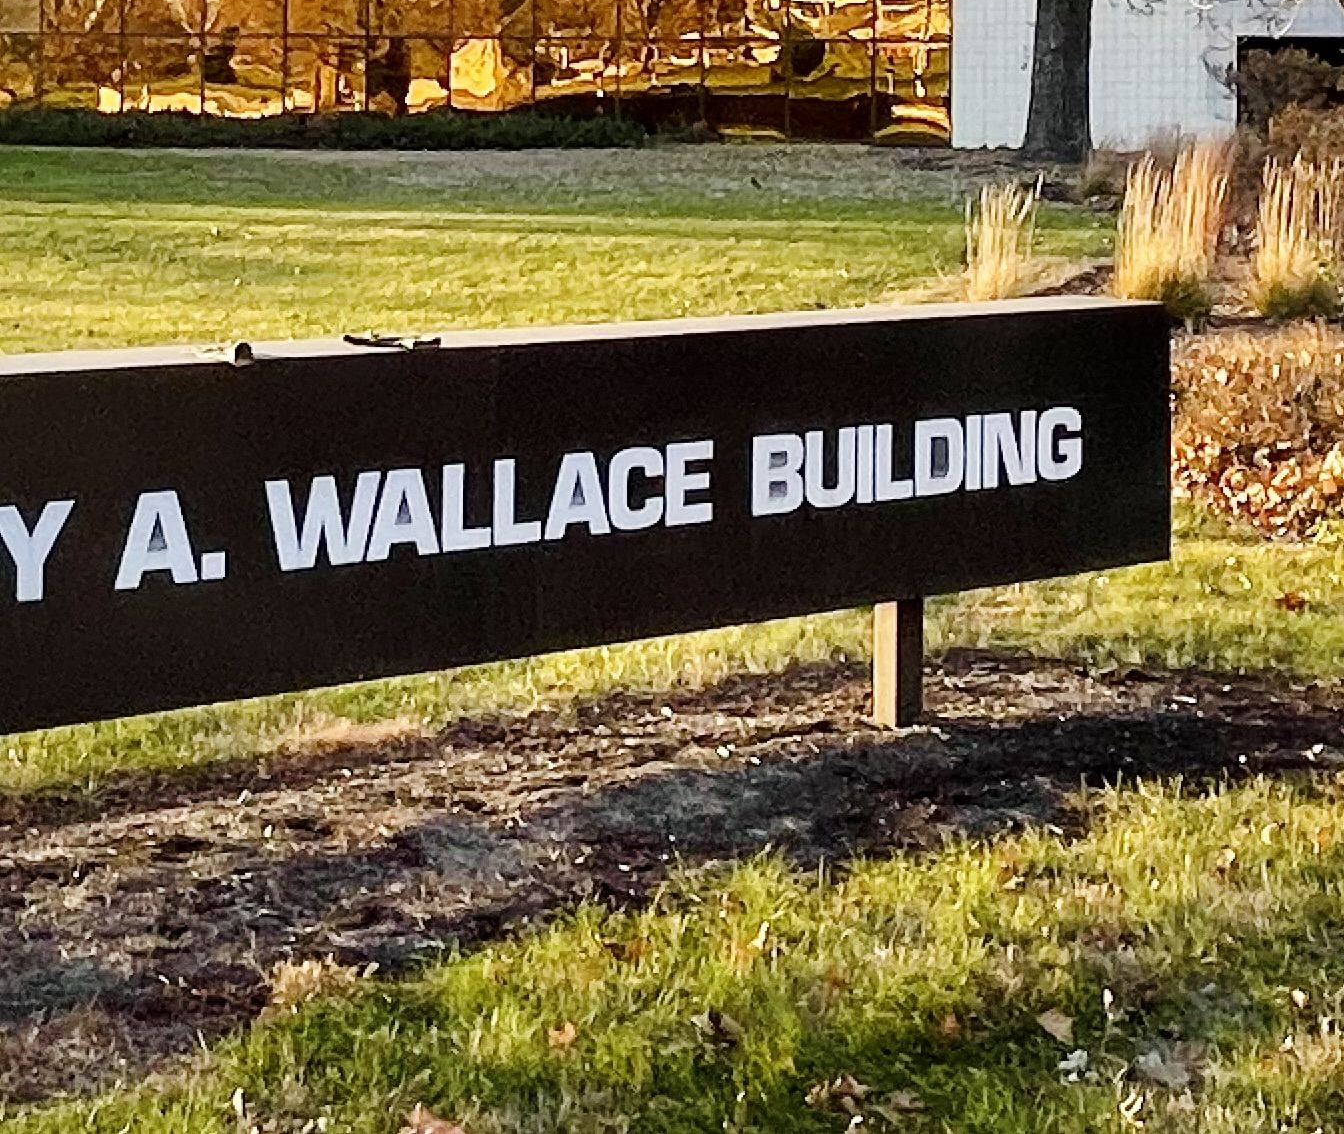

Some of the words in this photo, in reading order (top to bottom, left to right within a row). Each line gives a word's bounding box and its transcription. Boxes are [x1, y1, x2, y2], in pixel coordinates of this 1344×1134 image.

[114, 490, 226, 590] A.
[264, 440, 714, 572] WALLACE
[751, 406, 1083, 517] BUILDING
